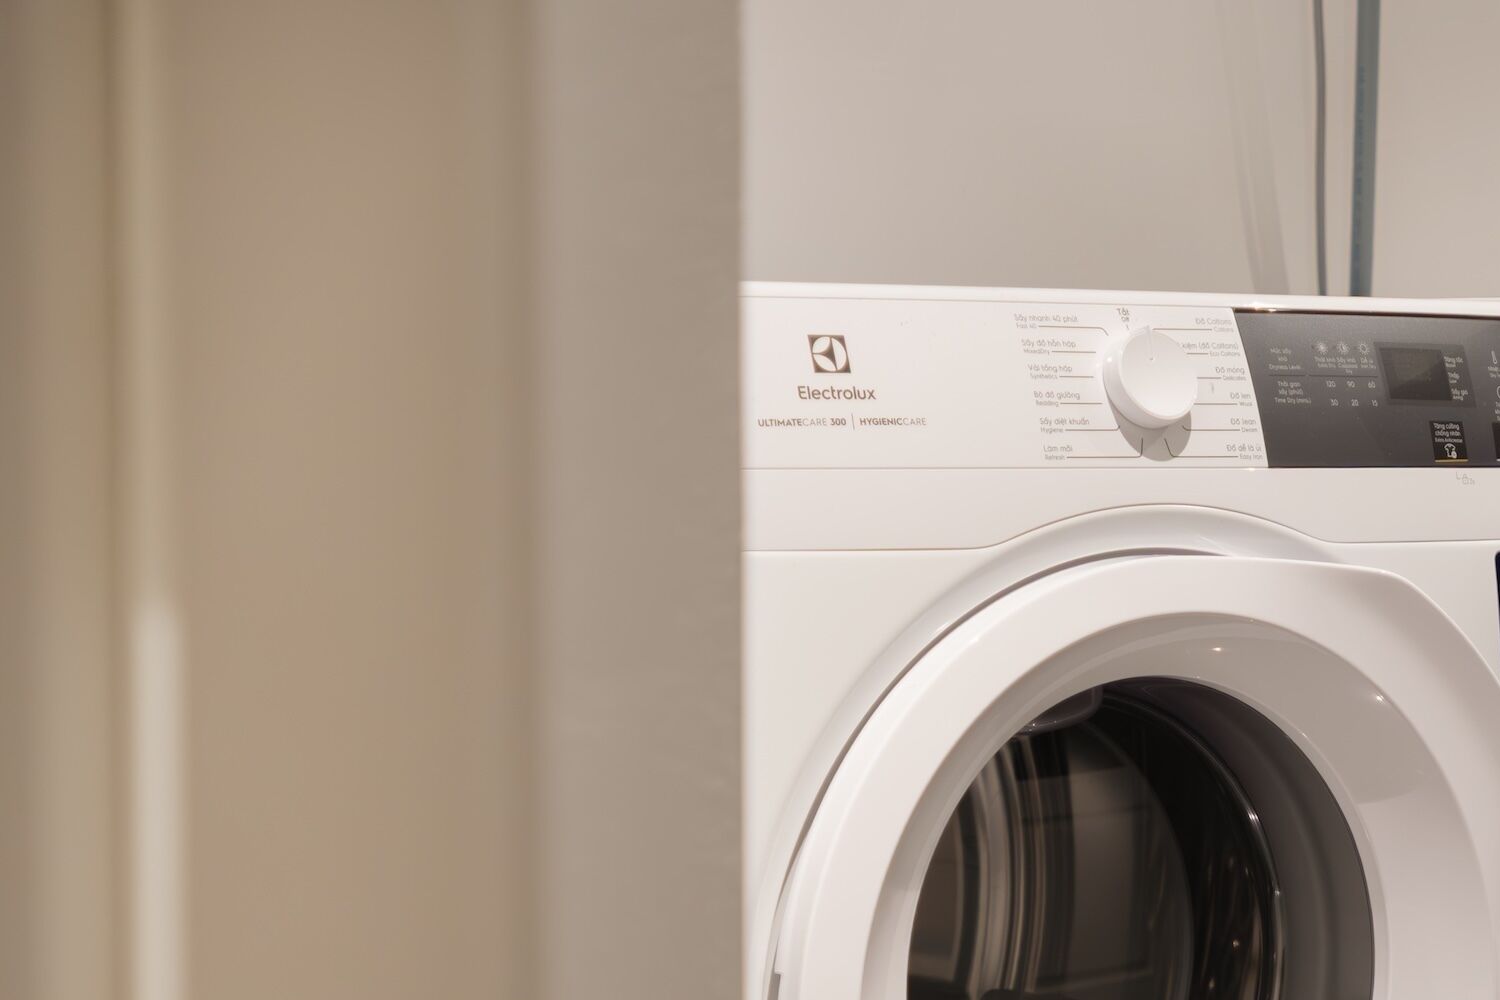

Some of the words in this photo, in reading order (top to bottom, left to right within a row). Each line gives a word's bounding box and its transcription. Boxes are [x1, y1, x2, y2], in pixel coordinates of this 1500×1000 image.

[797, 385, 876, 400] Electrolux
[757, 418, 827, 427] ULTIMATECARE
[830, 418, 847, 426] 300
[859, 417, 927, 426] HYGIENICCARE
